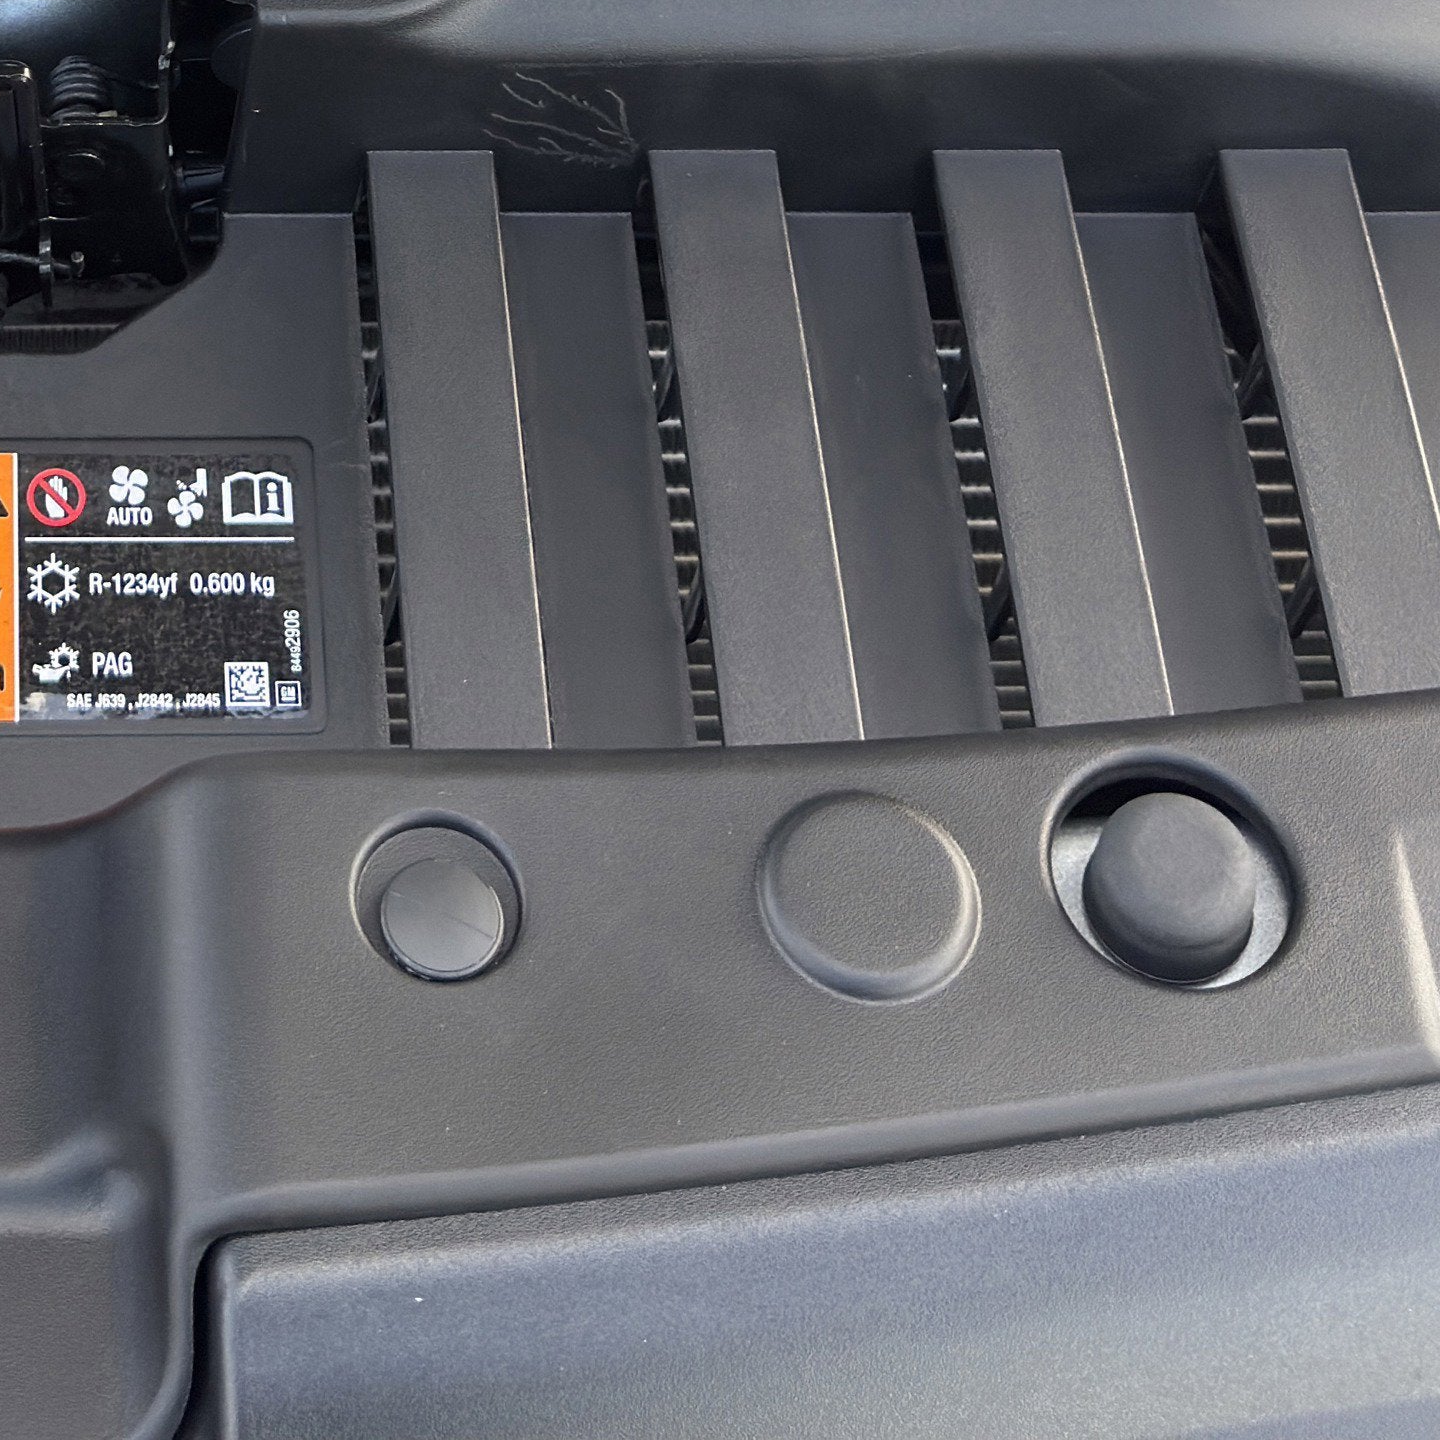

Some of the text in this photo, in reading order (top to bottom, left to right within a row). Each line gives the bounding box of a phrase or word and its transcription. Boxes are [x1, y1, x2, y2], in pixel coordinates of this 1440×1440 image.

[106, 506, 153, 527] AUTO
[88, 571, 276, 600] R-1234yf 0.600 kg
[283, 609, 302, 672] 84492906
[92, 651, 133, 677] PAG
[66, 692, 92, 708] SAE
[182, 692, 221, 708] J2845
